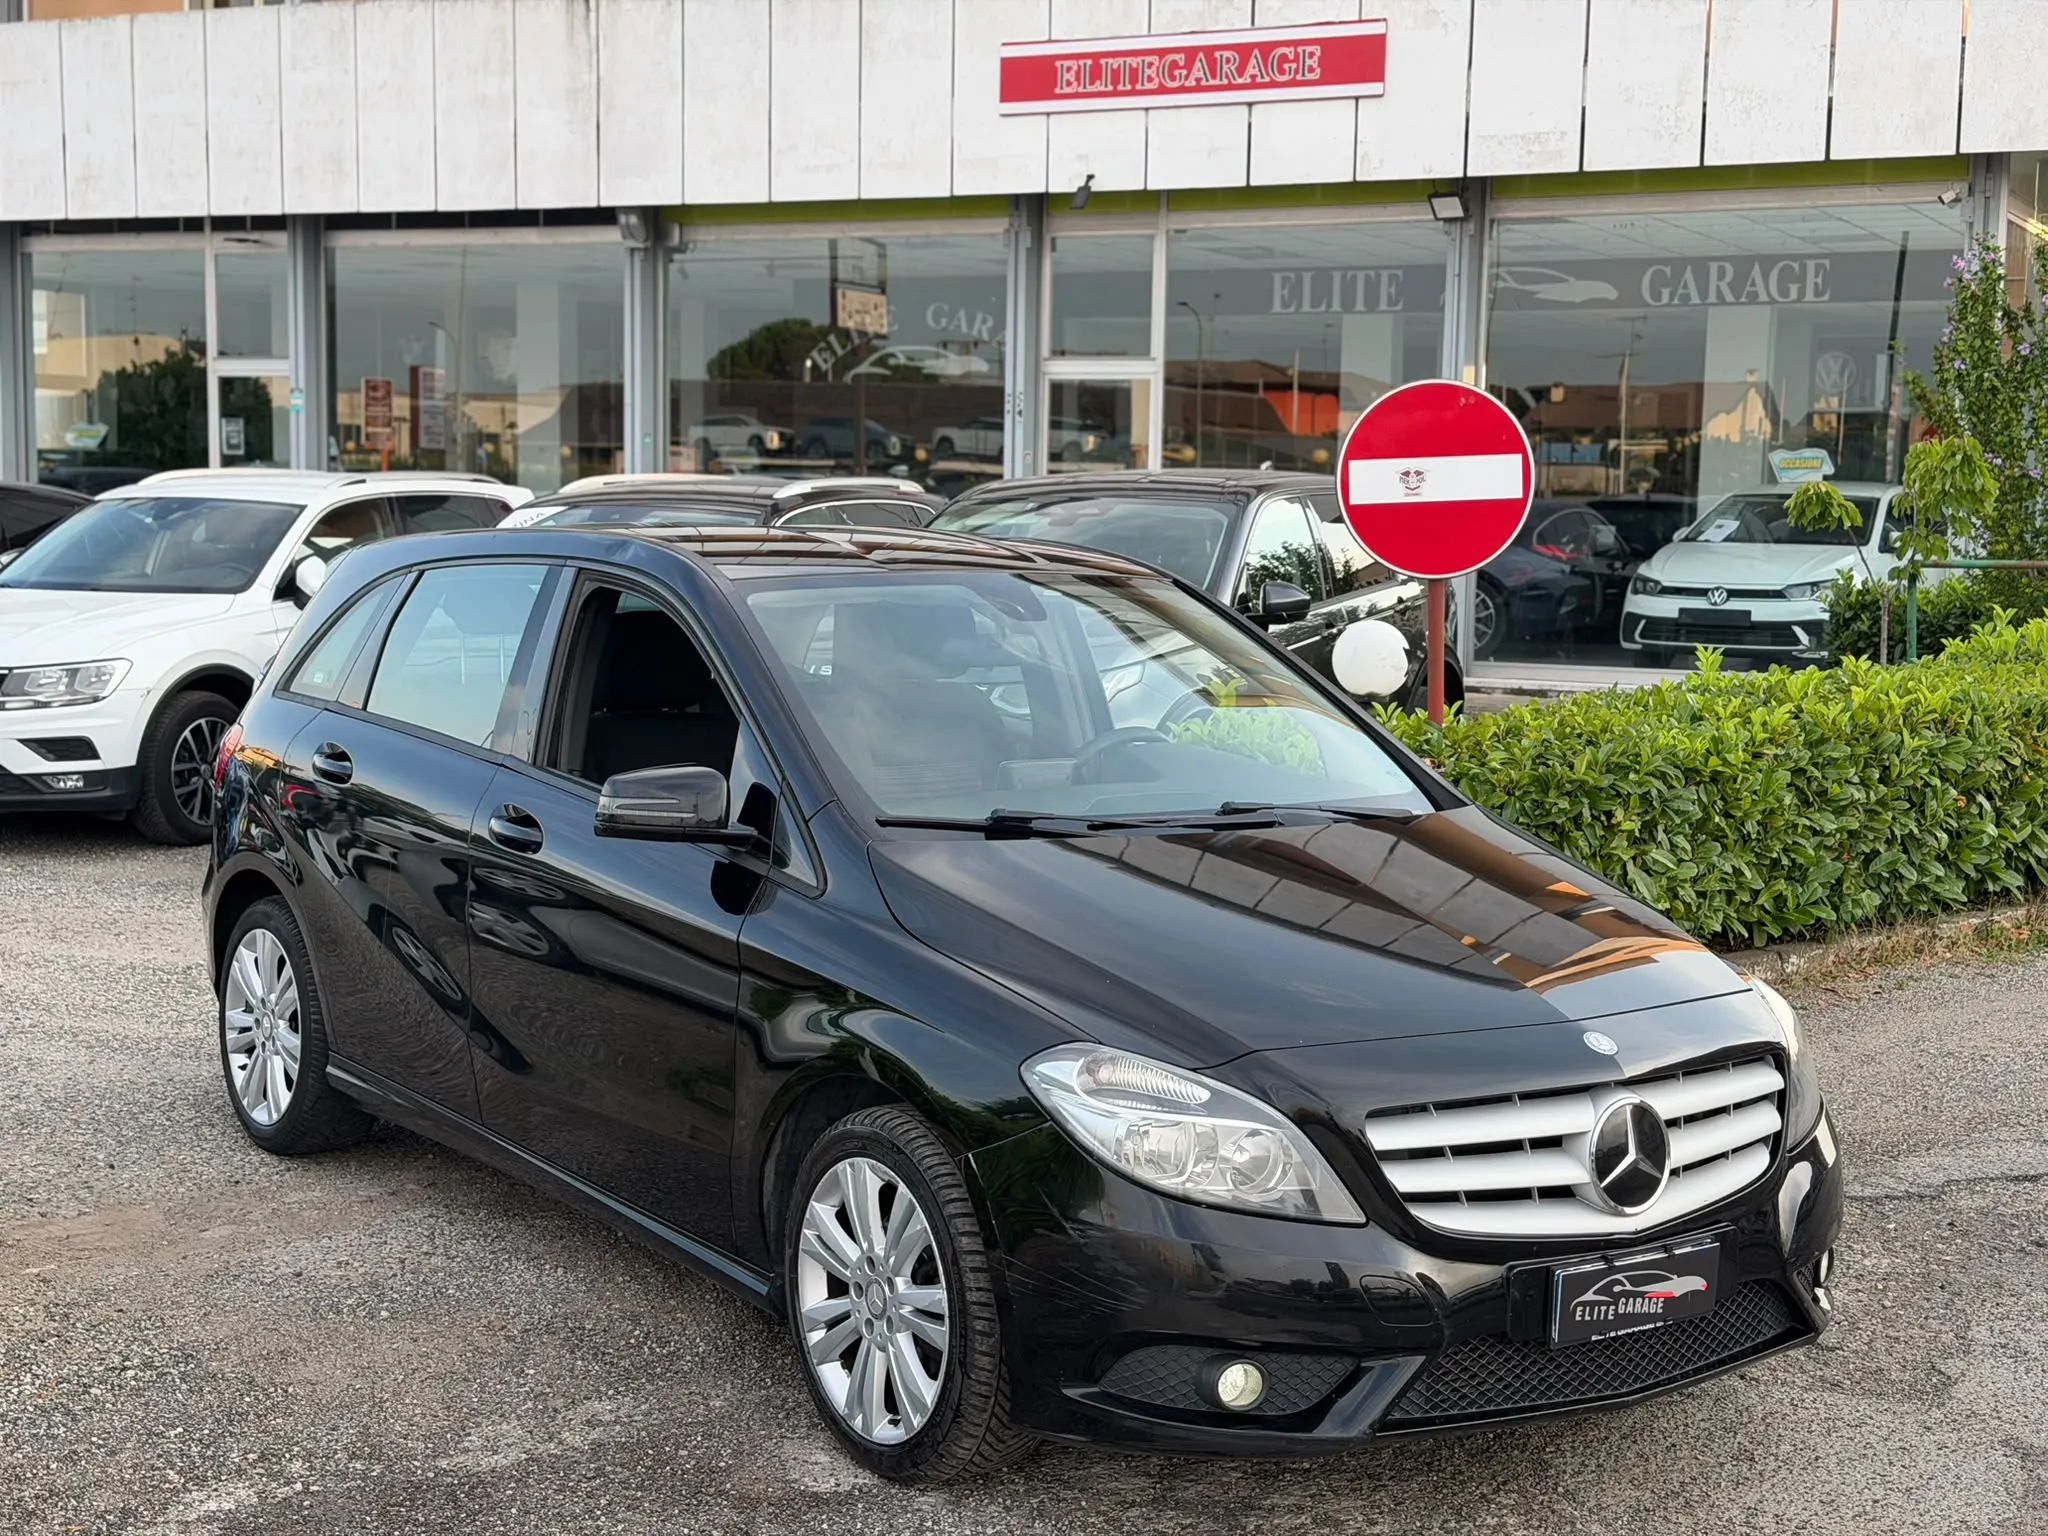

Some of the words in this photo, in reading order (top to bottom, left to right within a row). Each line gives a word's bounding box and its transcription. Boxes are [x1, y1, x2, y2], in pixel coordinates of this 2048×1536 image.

[1054, 45, 1322, 94] ELITEGARAGE
[1269, 269, 1403, 313] ELITE
[1641, 259, 1831, 306] GARAGE
[809, 303, 899, 372] ELIE
[1575, 1306, 1617, 1321] ELITE
[1617, 1297, 1665, 1314] GARAGE
